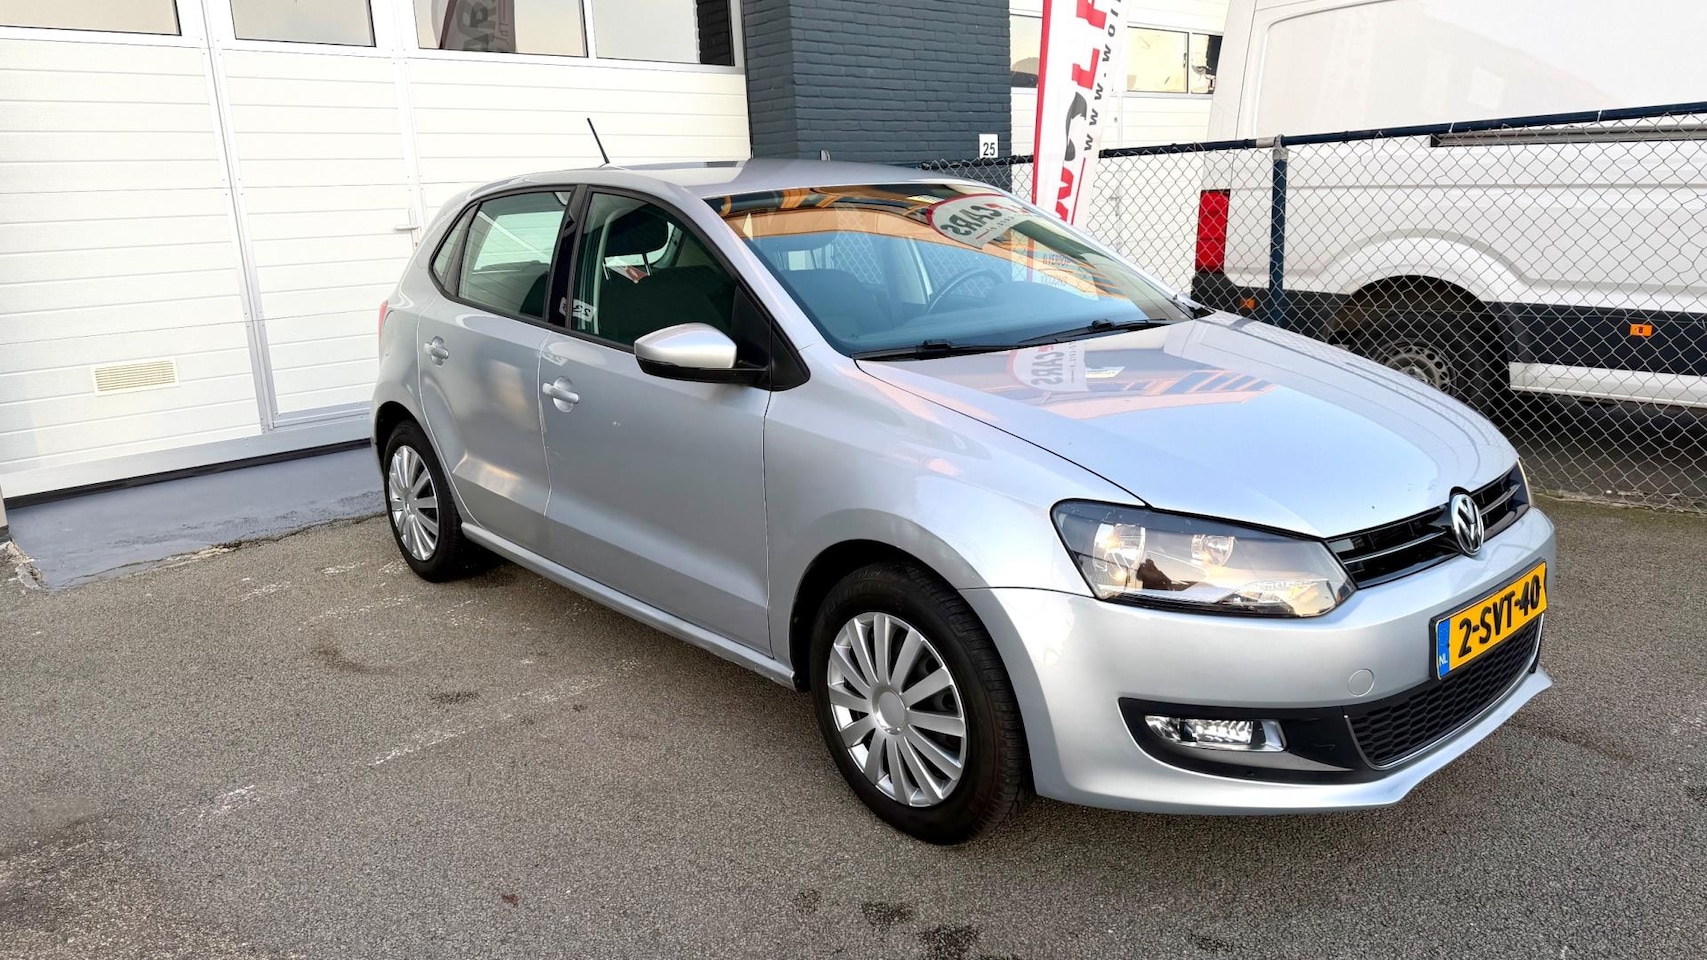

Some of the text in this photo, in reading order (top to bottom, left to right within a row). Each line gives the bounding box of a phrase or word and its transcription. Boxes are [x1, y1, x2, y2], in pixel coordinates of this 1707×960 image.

[983, 142, 995, 156] 25
[1458, 574, 1541, 659] 2-SVT-40
[1438, 652, 1449, 667] NL
